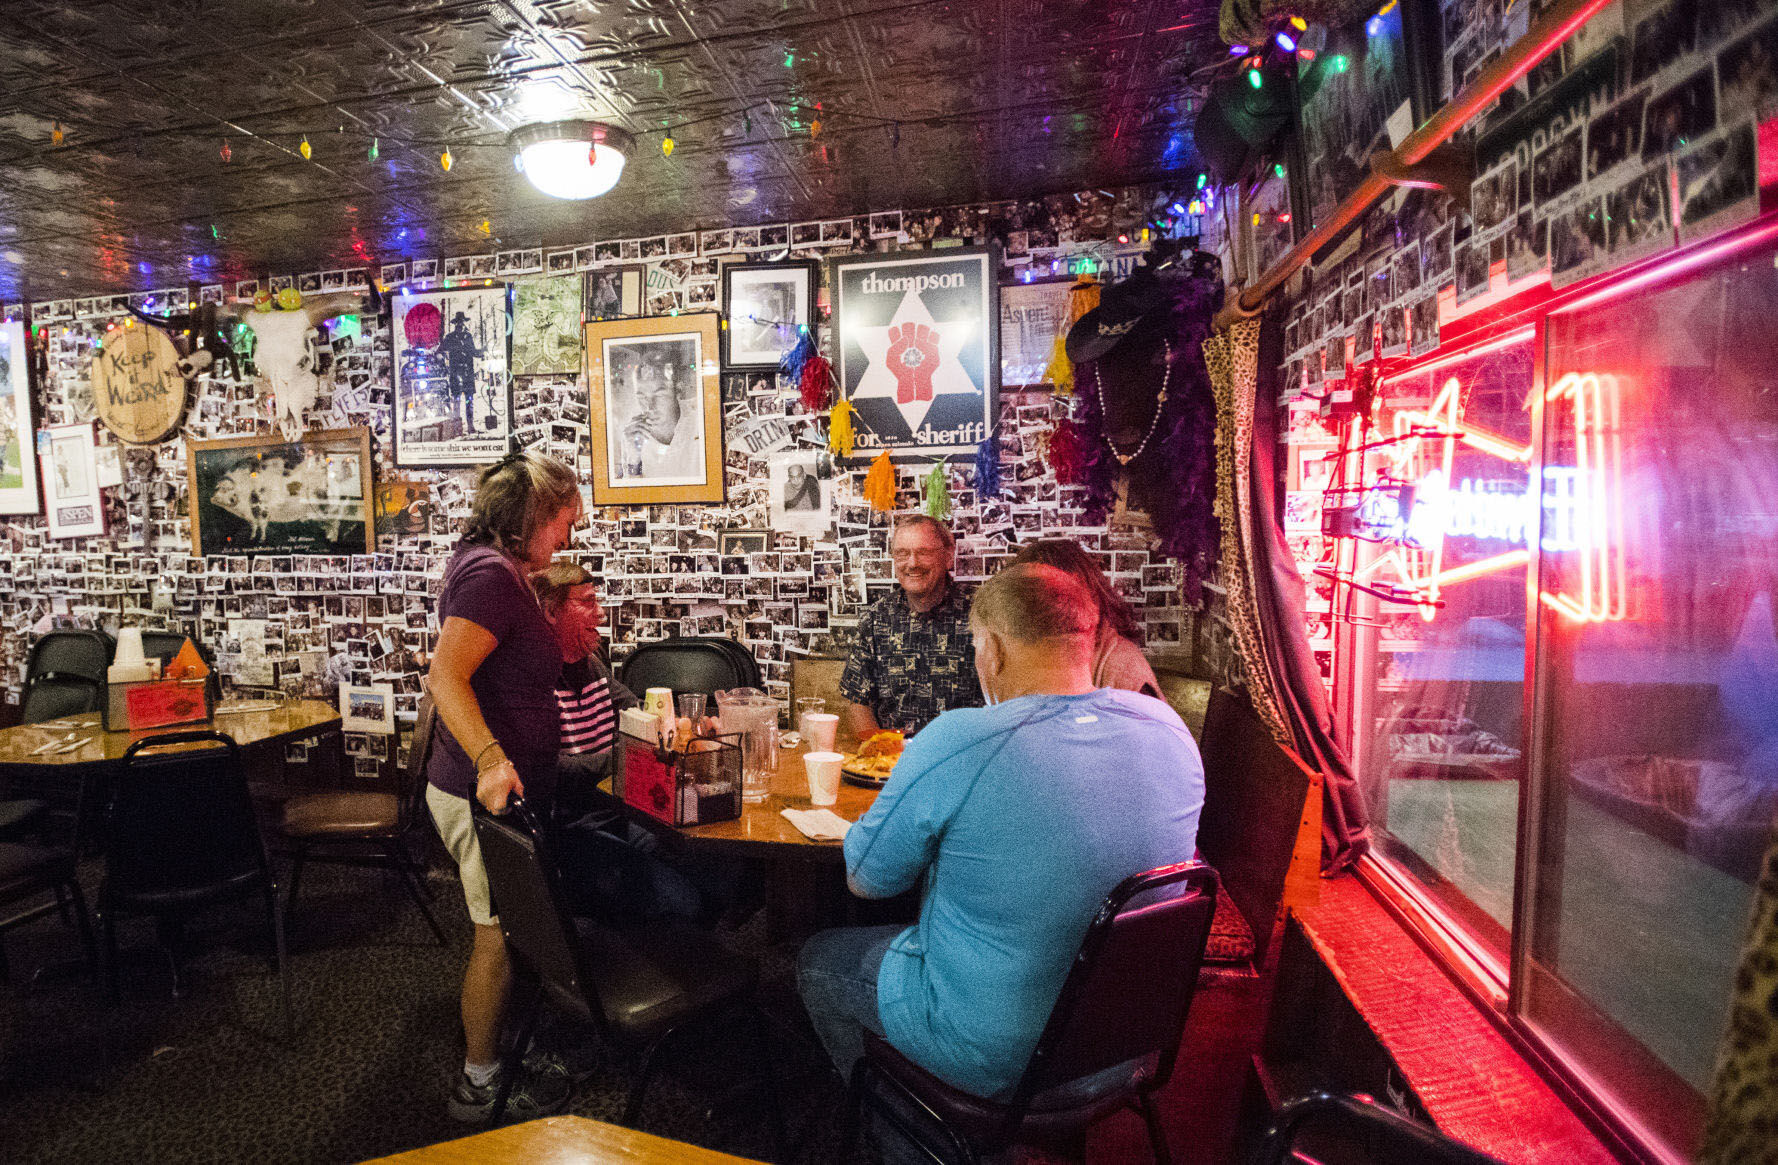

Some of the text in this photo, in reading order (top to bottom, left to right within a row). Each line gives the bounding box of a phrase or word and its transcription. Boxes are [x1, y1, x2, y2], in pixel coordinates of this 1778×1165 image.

[861, 271, 966, 295] thompson
[111, 351, 156, 376] Keep
[851, 421, 985, 448] for sheriff
[447, 443, 460, 452] shit
[462, 444, 471, 452] we
[492, 444, 504, 452] eat
